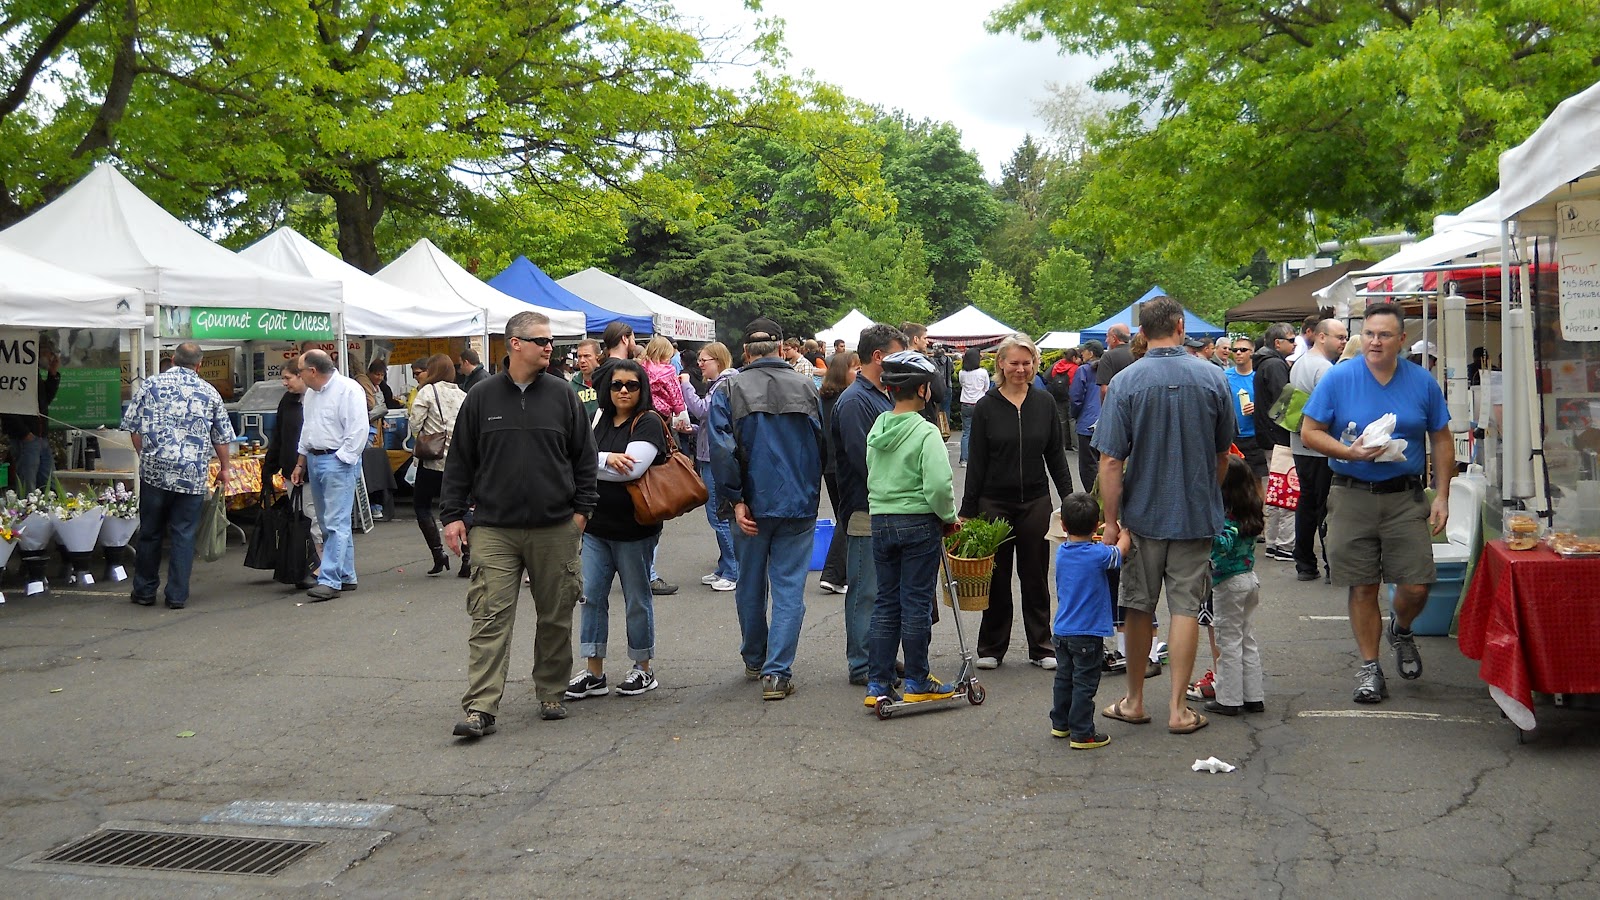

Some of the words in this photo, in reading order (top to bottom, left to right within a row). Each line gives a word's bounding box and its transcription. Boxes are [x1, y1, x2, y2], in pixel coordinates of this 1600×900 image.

[1561, 252, 1598, 274] FRUIT
[197, 311, 252, 331] Gourmet
[258, 312, 288, 334] Goat
[292, 311, 330, 331] Cheese
